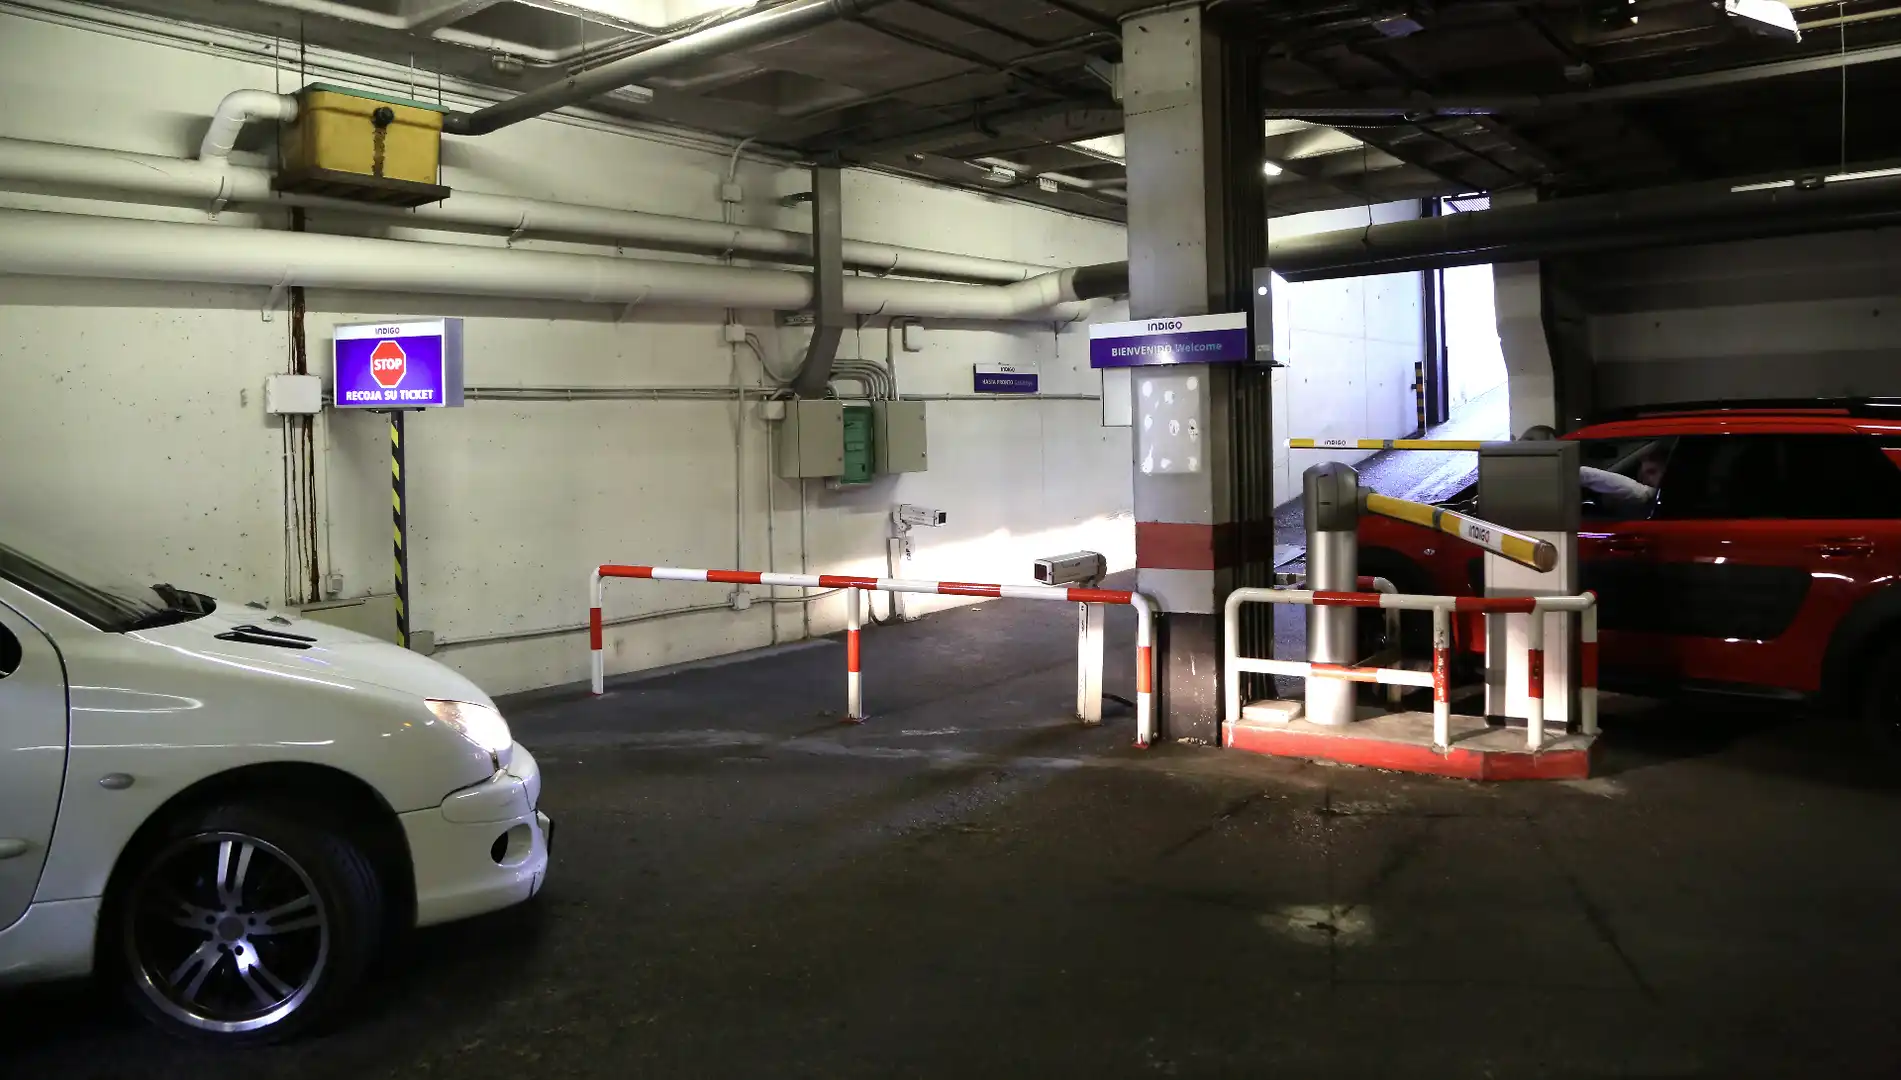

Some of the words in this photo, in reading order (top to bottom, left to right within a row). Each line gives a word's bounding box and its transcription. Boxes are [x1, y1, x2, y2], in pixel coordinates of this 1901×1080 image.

[375, 327, 400, 335] INDIGO
[1147, 321, 1183, 331] INDIGO
[1111, 344, 1172, 357] BIENVENIDO
[1175, 342, 1222, 352] Welcome
[373, 358, 403, 371] STOP
[346, 390, 382, 401] RECOJA
[384, 390, 397, 401] SU
[399, 389, 434, 400] TICKET
[1468, 524, 1490, 544] INDIGO
